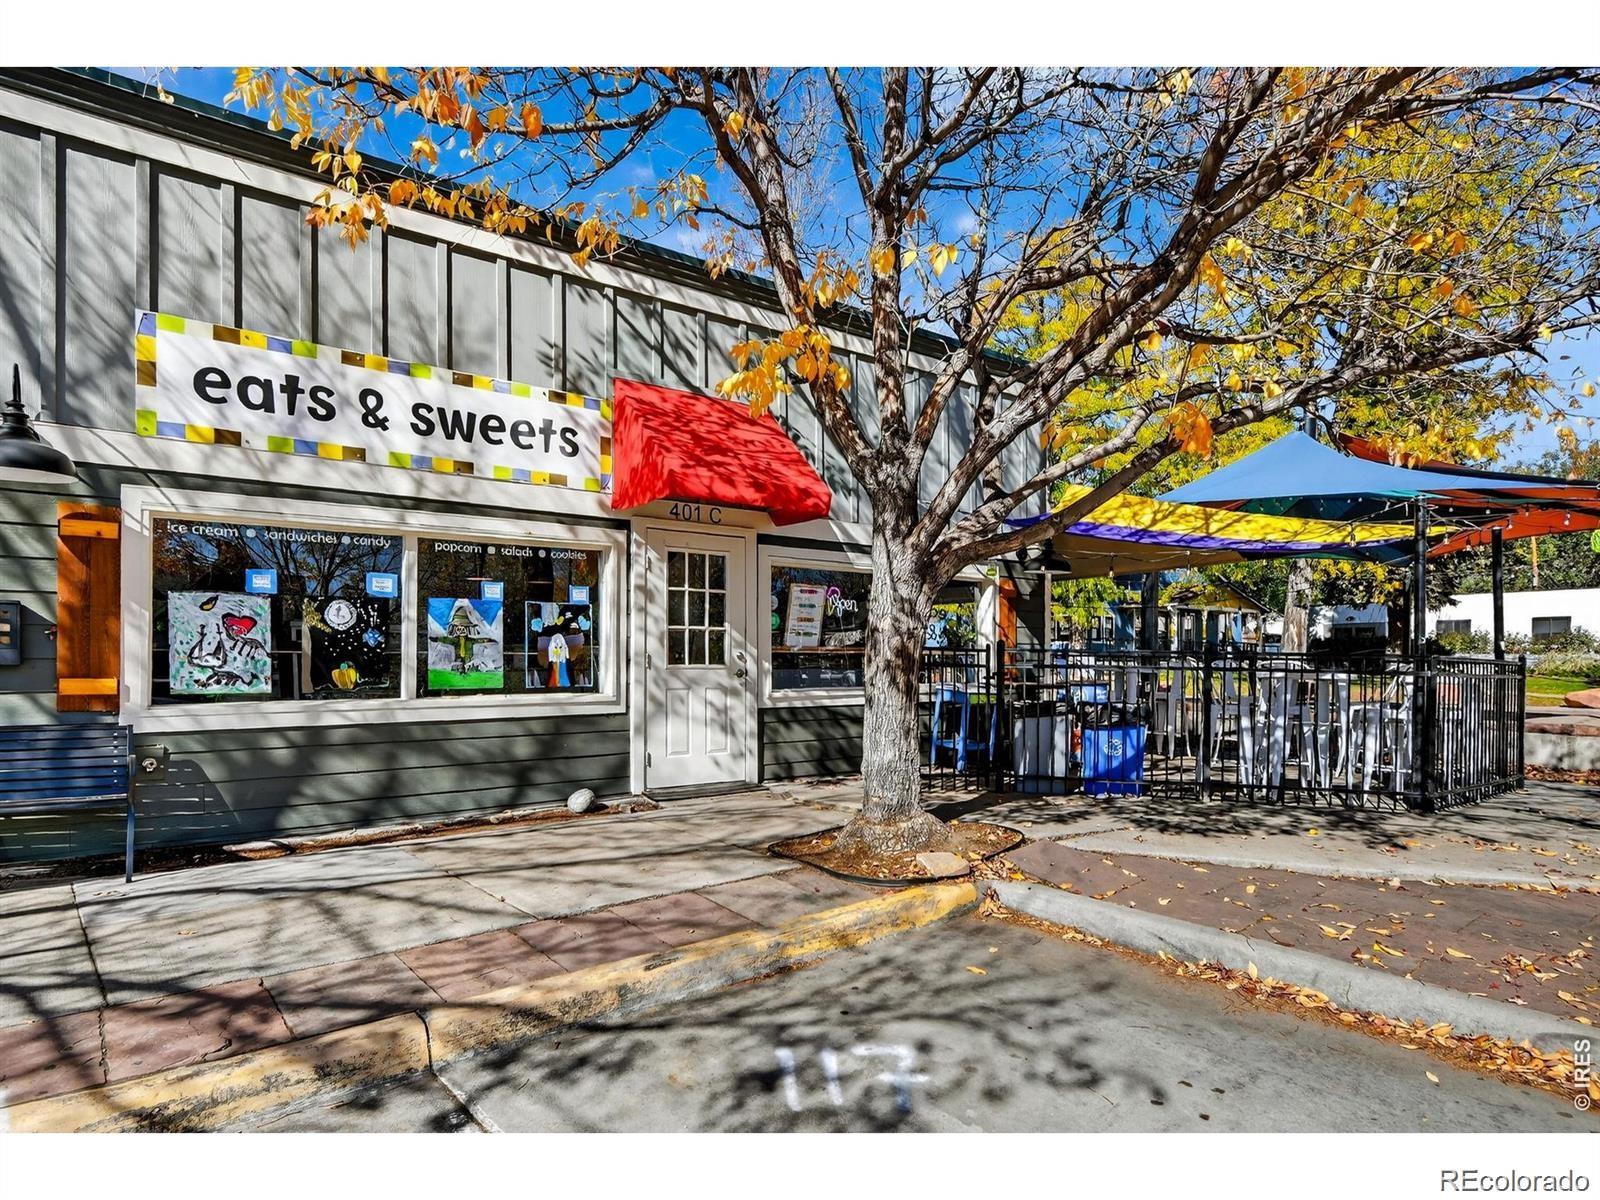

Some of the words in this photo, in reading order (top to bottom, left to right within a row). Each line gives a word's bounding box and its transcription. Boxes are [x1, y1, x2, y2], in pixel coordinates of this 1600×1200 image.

[193, 366, 336, 422] eats
[359, 388, 390, 431] &
[410, 401, 581, 459] sweets
[669, 502, 702, 523] 401
[709, 506, 723, 525] C
[167, 521, 187, 533] ice
[192, 524, 239, 538] cream
[264, 529, 337, 543] sandwiches
[353, 536, 391, 549] candy
[501, 545, 533, 557] salads
[550, 551, 587, 560] cookies
